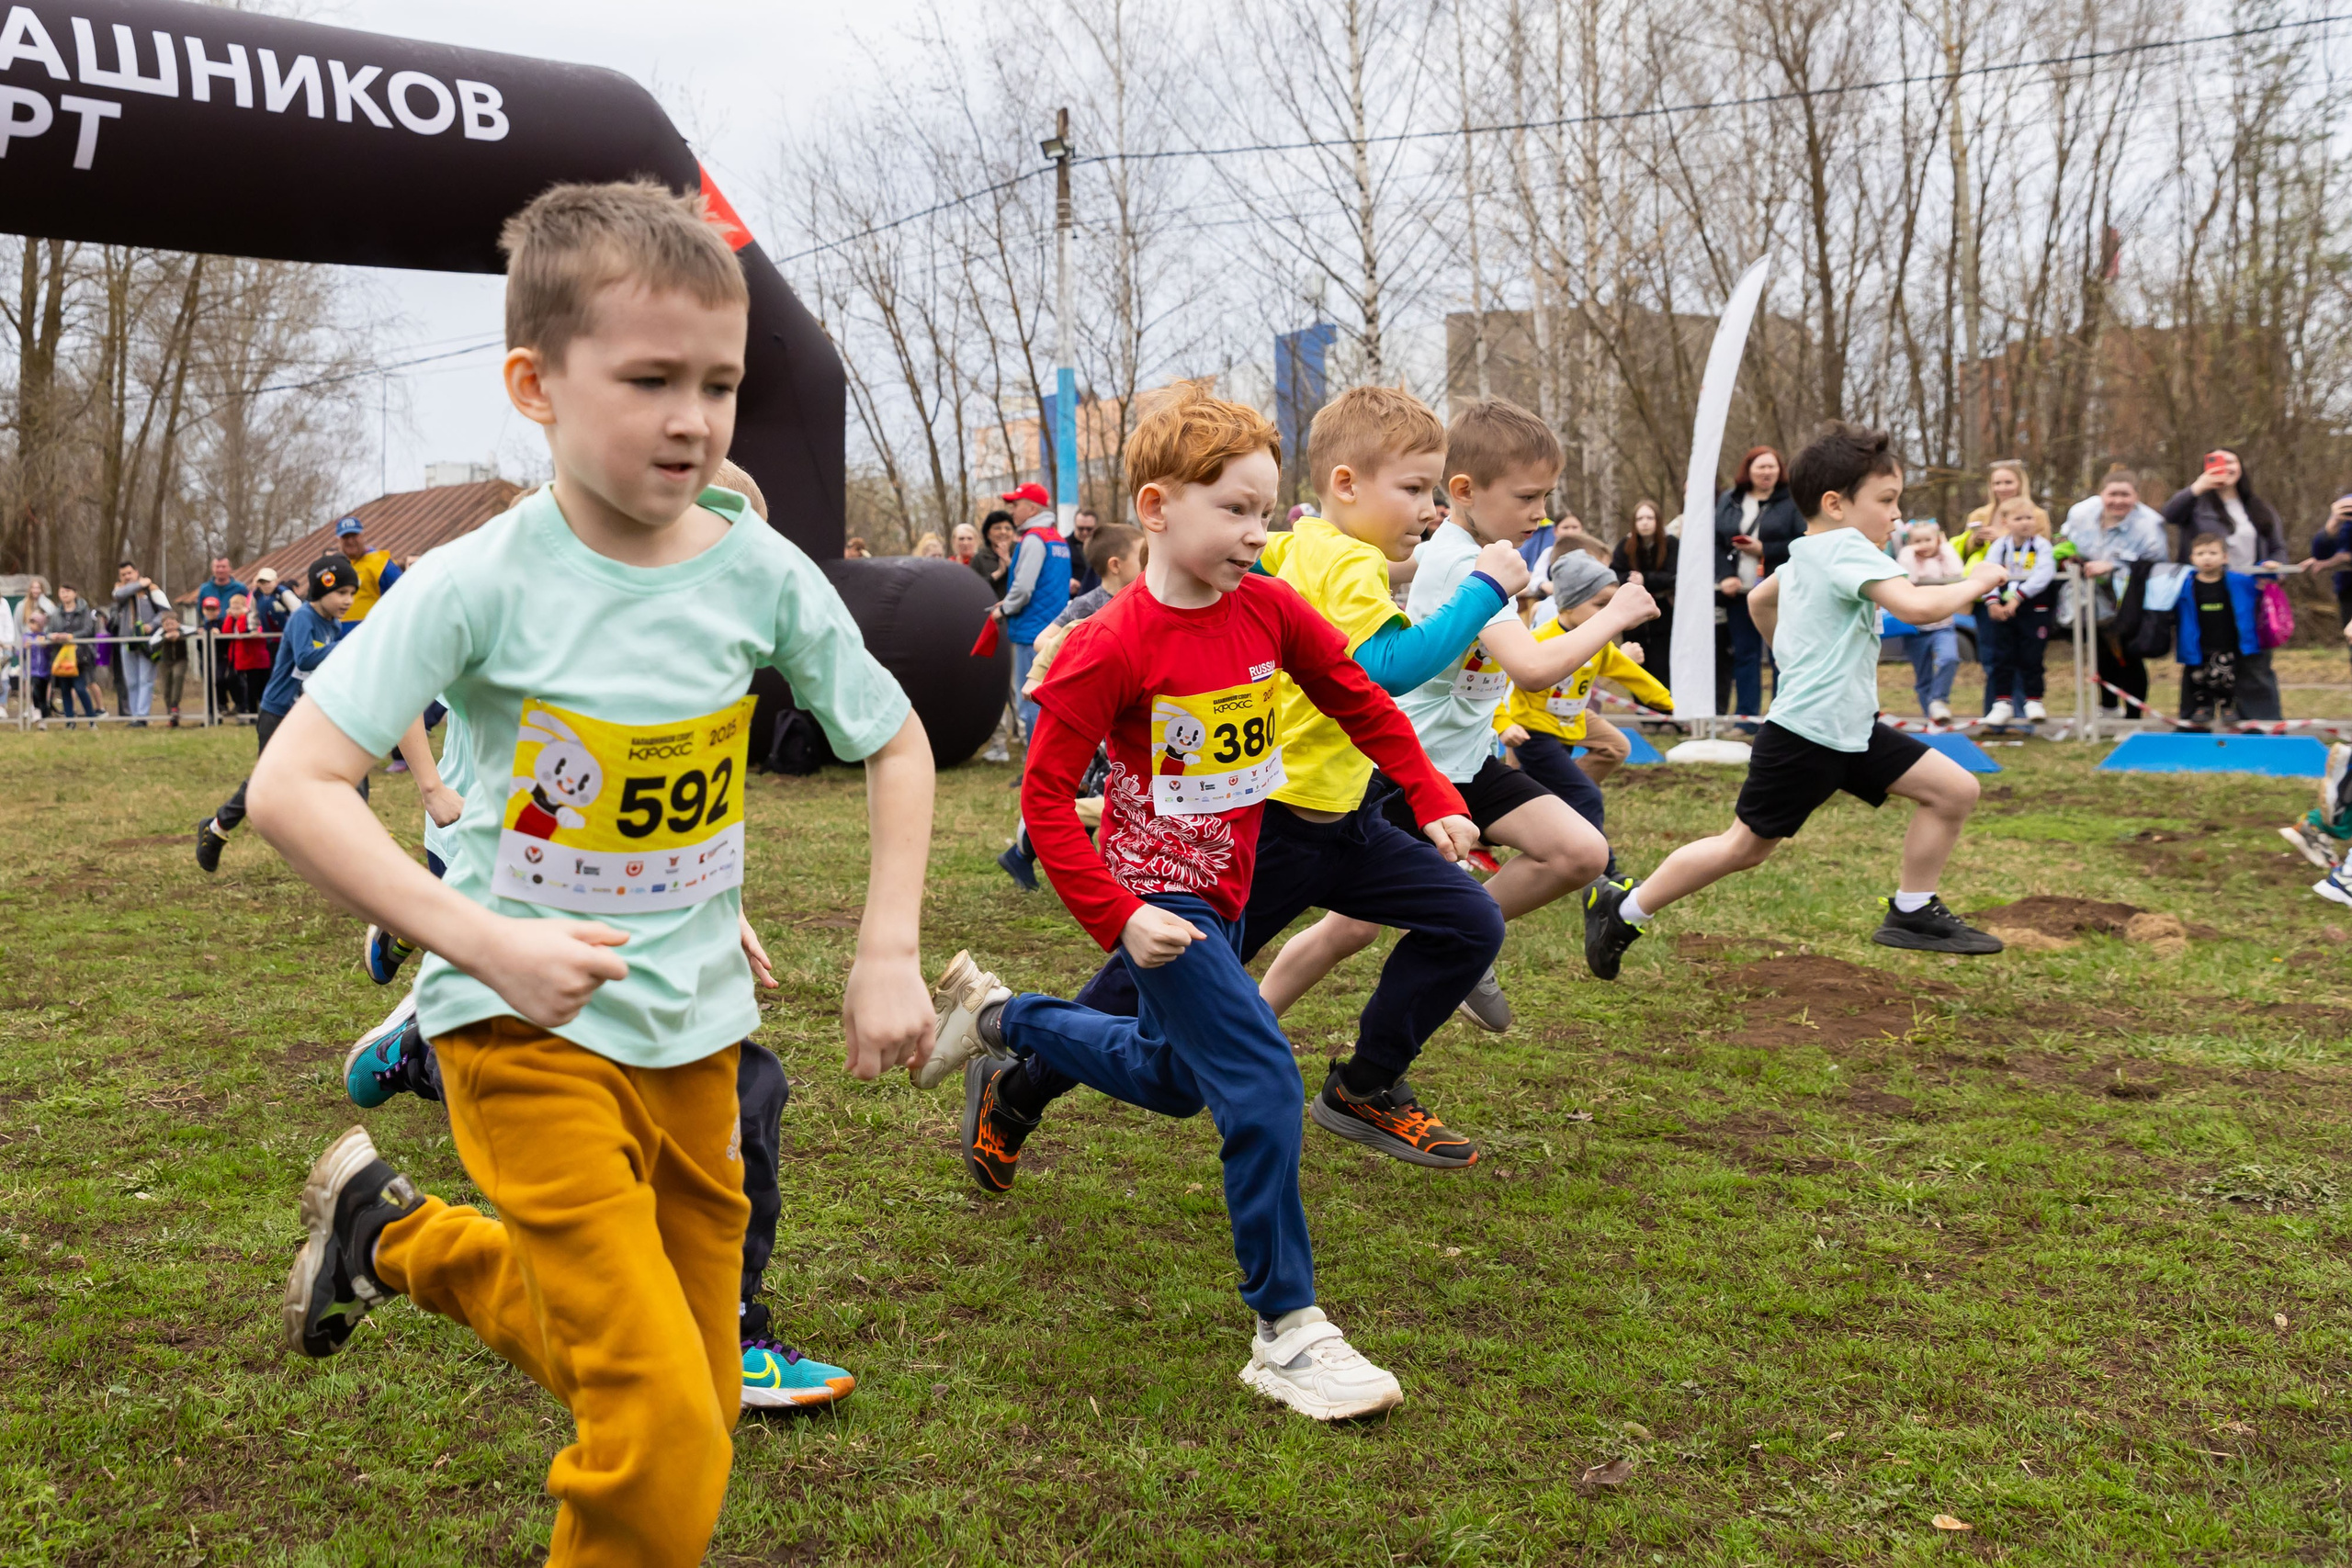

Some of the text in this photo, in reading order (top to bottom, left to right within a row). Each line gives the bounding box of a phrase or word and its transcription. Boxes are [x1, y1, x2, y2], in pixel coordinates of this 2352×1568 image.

[0, 6, 509, 141] АШНИКОВ
[0, 85, 121, 170] РТ
[1249, 660, 1275, 677] RUSSIA
[1214, 700, 1253, 714] КРОСС
[1214, 707, 1274, 763] 380
[628, 742, 693, 761] КРОСС
[616, 757, 732, 838] 592
